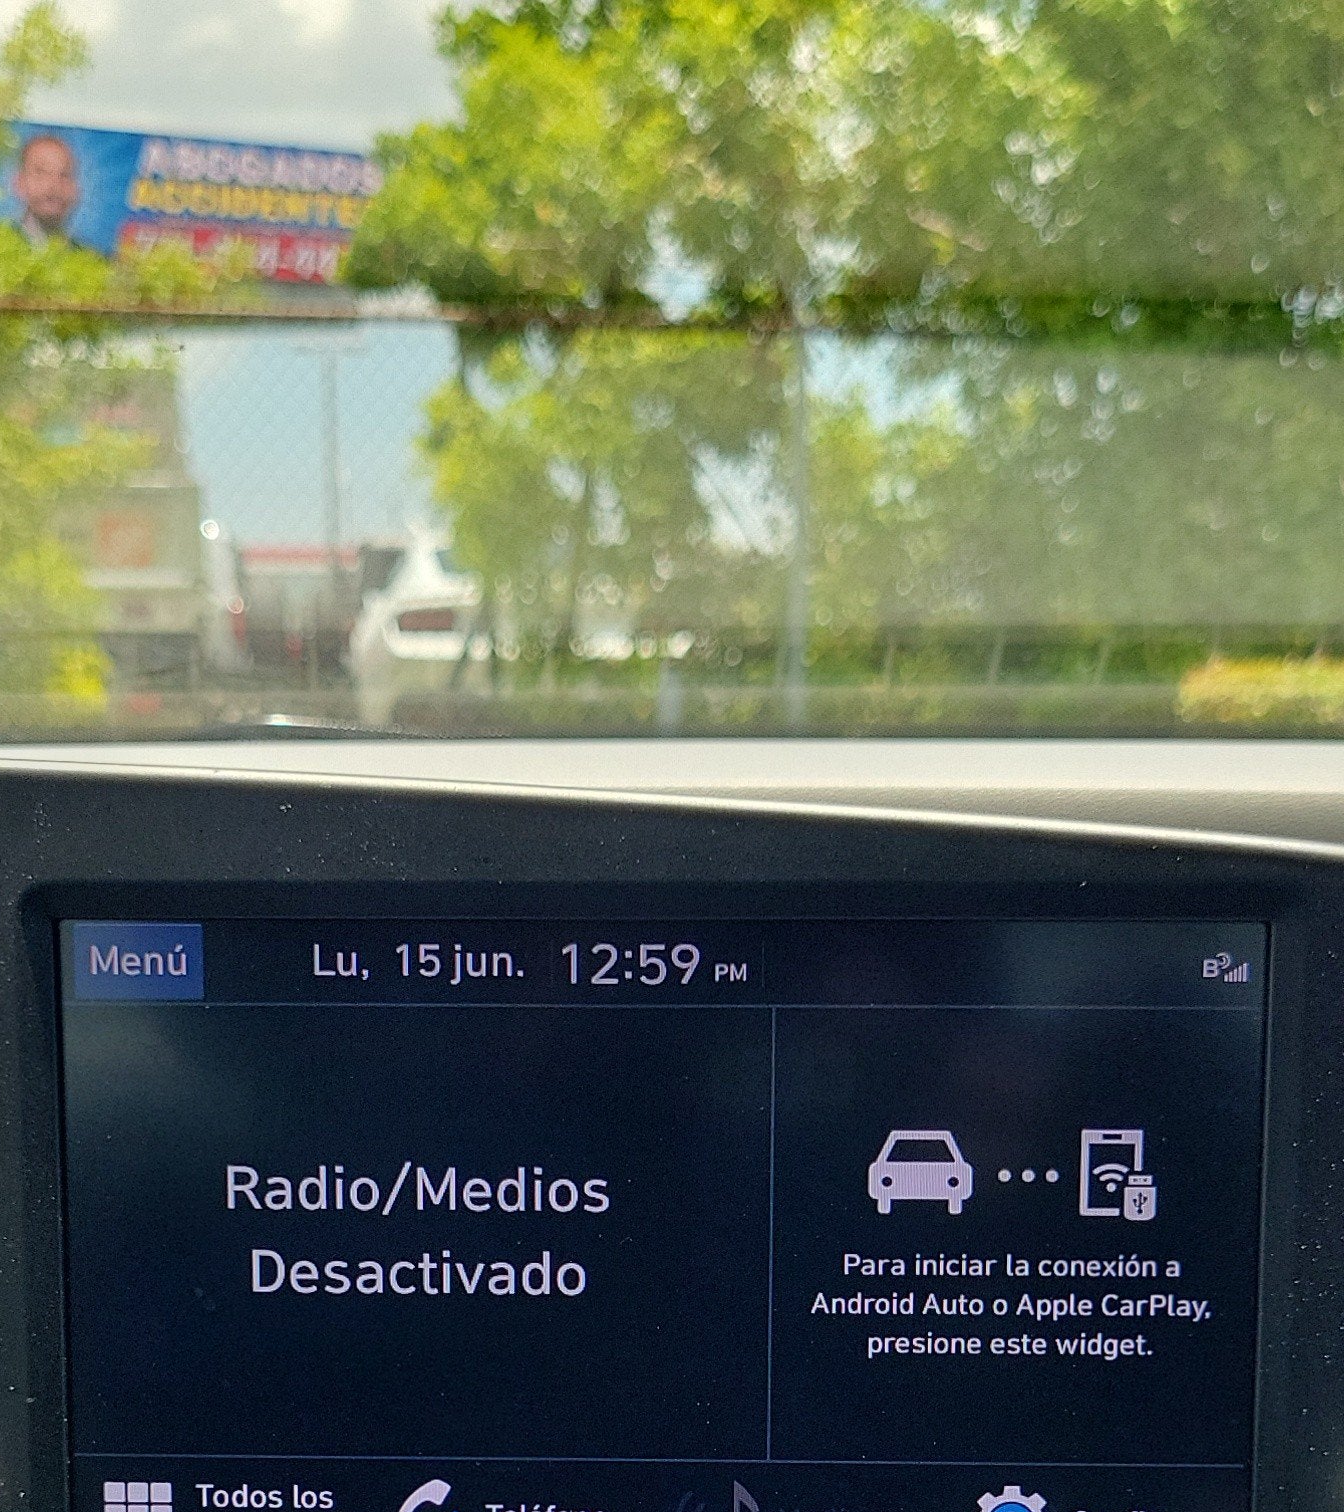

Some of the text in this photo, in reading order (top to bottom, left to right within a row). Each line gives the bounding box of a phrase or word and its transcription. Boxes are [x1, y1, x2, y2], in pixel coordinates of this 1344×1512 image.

[88, 944, 188, 976] Menú
[313, 943, 748, 985] Lu, 15 jun. 12:59 PM
[225, 1161, 611, 1215] Radio/Medios
[250, 1249, 588, 1296] Desactivado
[843, 1253, 1181, 1278] Para iniciar la conexión a
[810, 1292, 1212, 1323] Android Auto o Apple CarPlay,
[867, 1331, 1154, 1361] presione este widget.
[196, 1483, 334, 1510] Todos los
